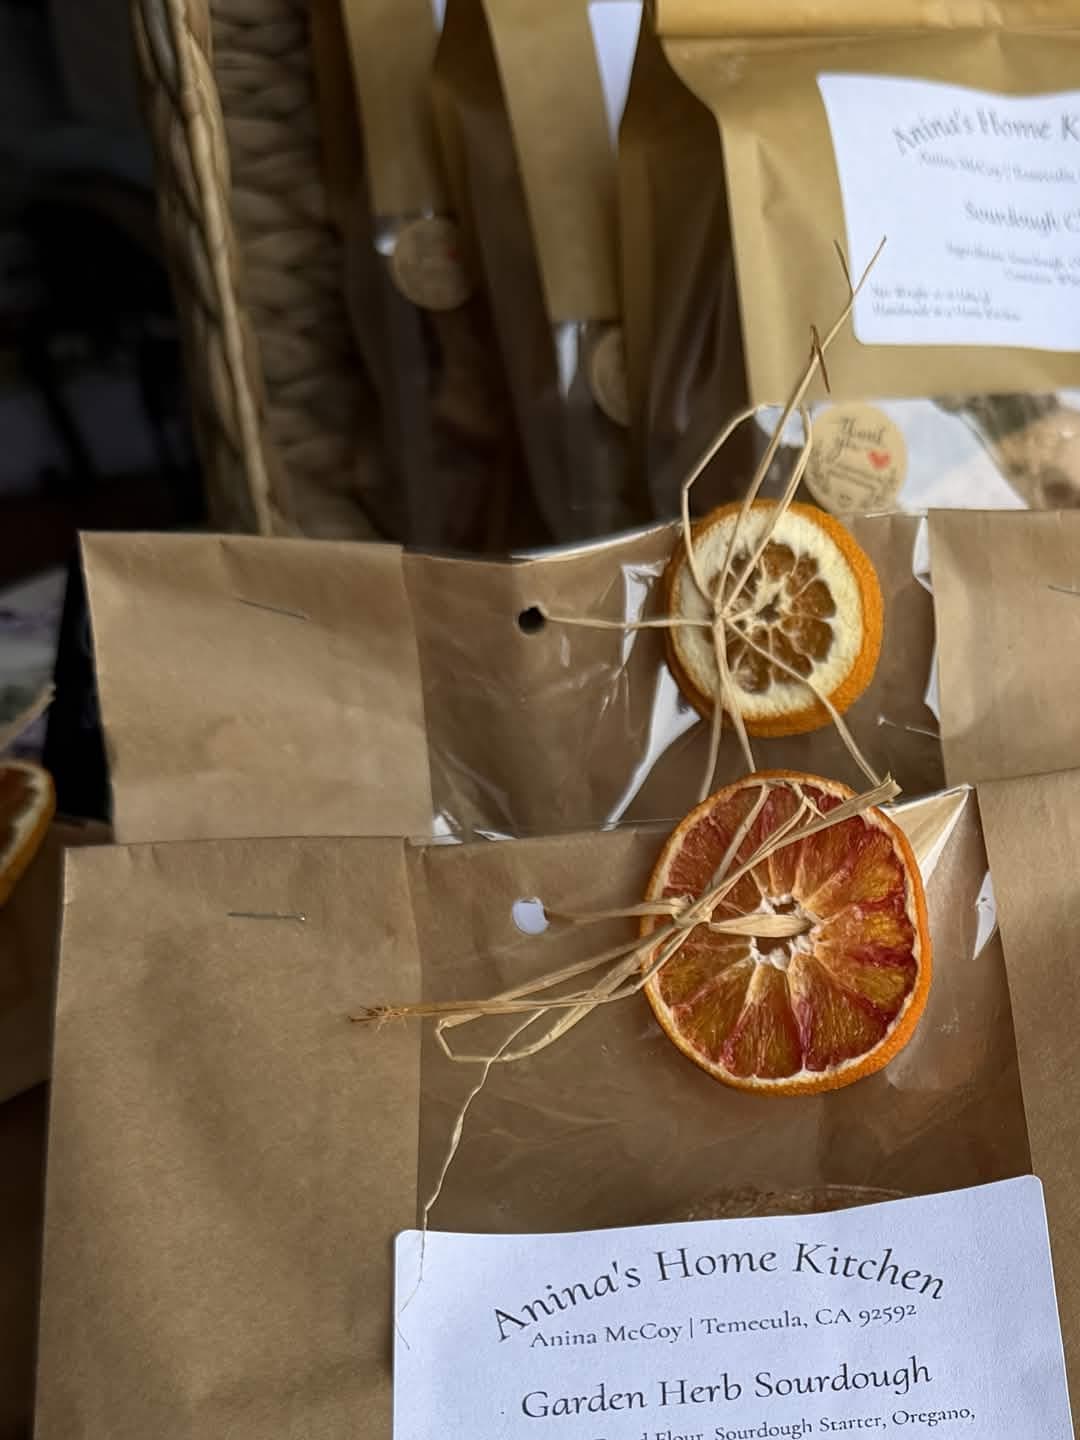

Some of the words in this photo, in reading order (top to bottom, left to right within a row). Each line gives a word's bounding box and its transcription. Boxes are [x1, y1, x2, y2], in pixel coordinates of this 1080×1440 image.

[892, 109, 971, 157] Anina's
[977, 107, 1054, 141] Home
[492, 1260, 642, 1343] Anina's
[655, 1246, 779, 1282] Home
[791, 1242, 946, 1300] Kitchen
[529, 1328, 598, 1349] Anina
[605, 1321, 684, 1345] McCoy
[700, 1308, 809, 1337] Temecula,
[815, 1305, 852, 1327] CA
[858, 1303, 918, 1329] 92592
[520, 1382, 647, 1419] Garden
[657, 1373, 742, 1408] Herb
[754, 1355, 933, 1399] Sourdough
[818, 1413, 888, 1434] Starter,
[891, 1407, 977, 1431] Oregano,
